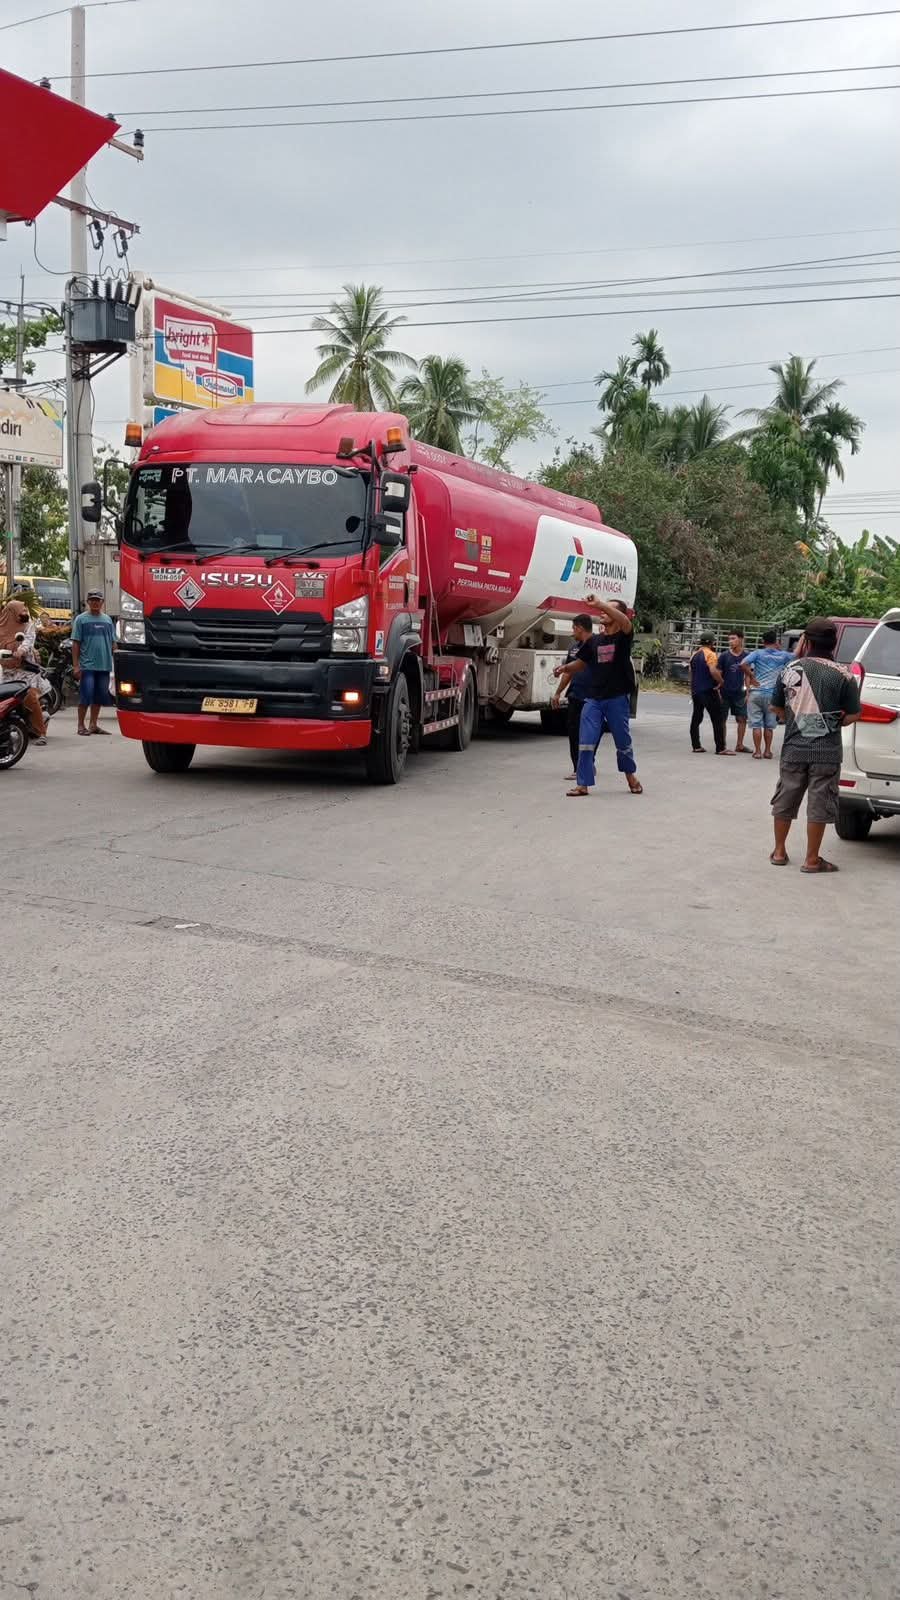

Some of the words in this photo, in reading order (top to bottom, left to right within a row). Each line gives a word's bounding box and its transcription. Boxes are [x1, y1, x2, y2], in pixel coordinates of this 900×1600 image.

[168, 326, 201, 348] bright
[185, 366, 195, 380] by
[171, 467, 200, 484] PT.
[206, 467, 338, 486] MARACAYBO
[148, 567, 188, 575] GIGA
[585, 558, 628, 581] PERTAMINA
[201, 572, 273, 588] ISUZU
[584, 577, 602, 591] PATRA
[602, 582, 622, 594] NIAGA
